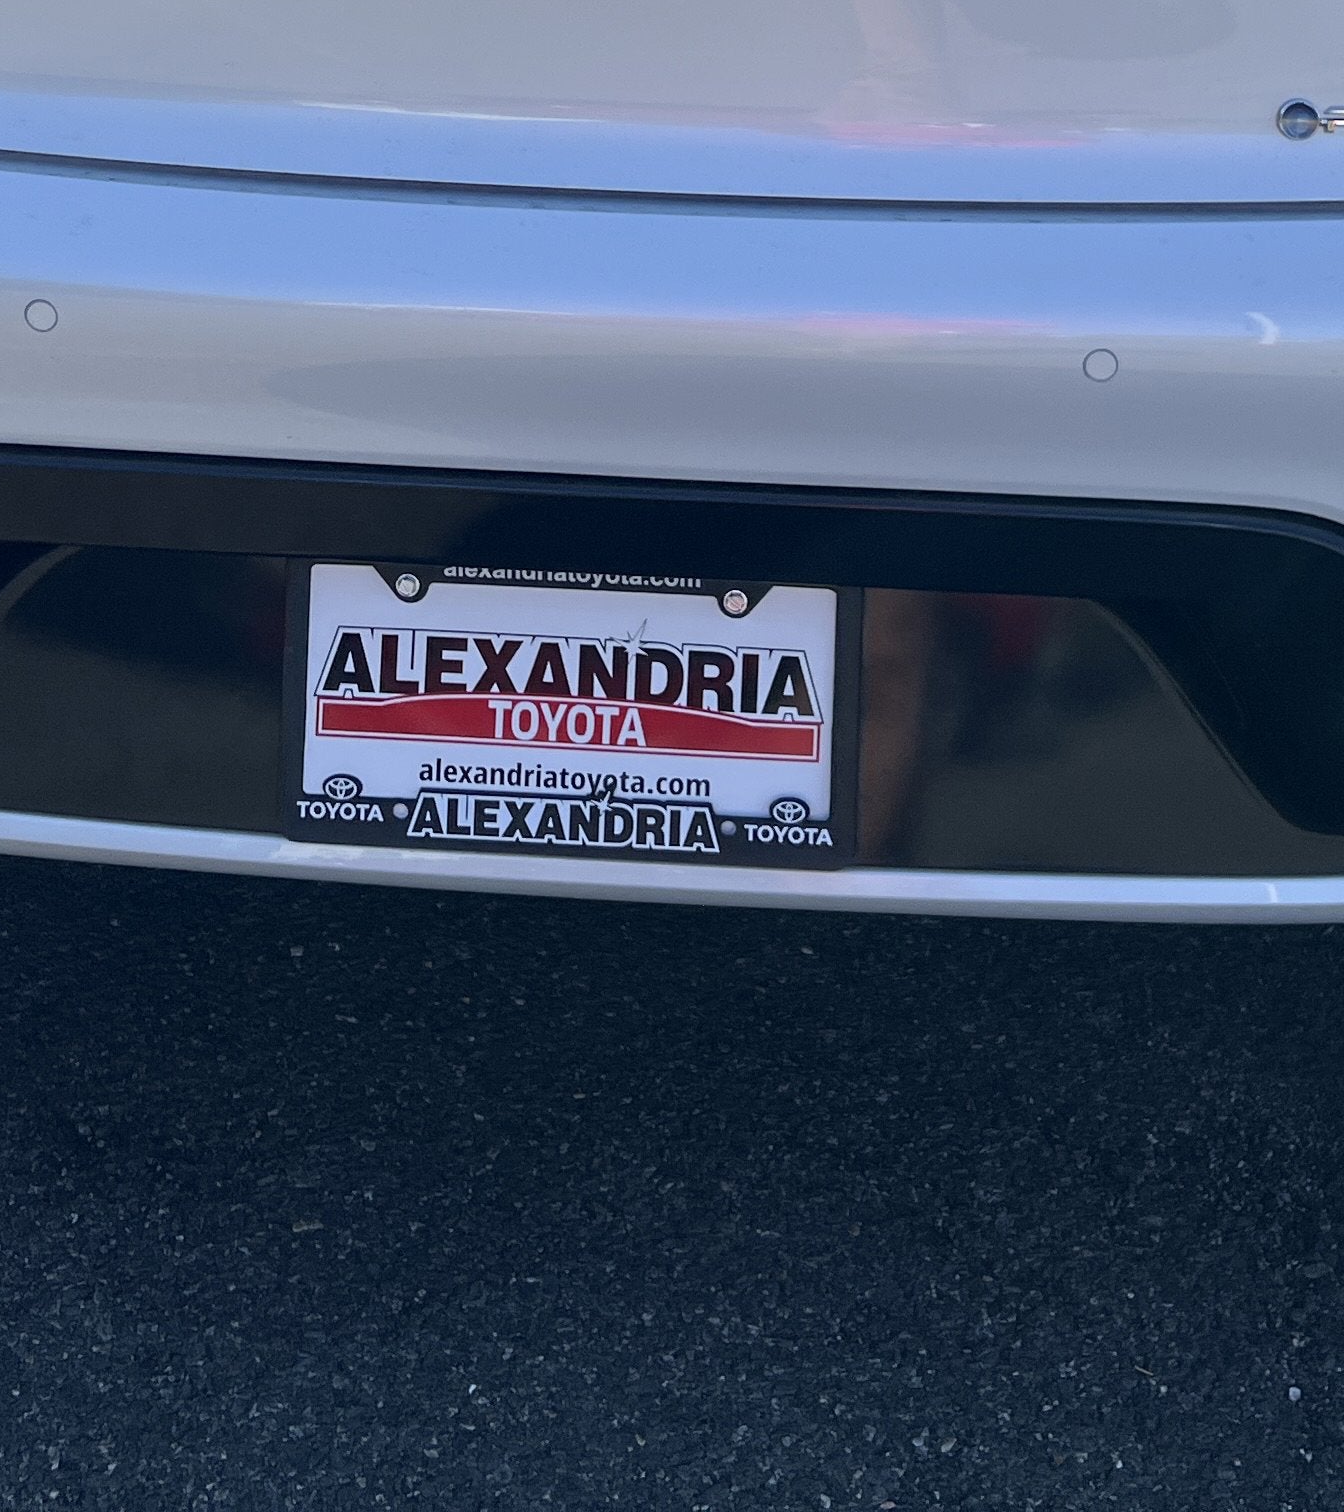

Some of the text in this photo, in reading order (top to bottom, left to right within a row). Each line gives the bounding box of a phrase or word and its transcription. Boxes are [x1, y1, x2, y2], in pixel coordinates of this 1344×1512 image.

[319, 630, 816, 718] ALEXANDRIA
[488, 699, 647, 748] TOYOTA
[418, 758, 711, 797] alexandriatoyota.com
[296, 800, 384, 822] TOYOTA
[409, 793, 718, 852] ALEXANDRIA
[743, 823, 834, 847] TOYOTA
